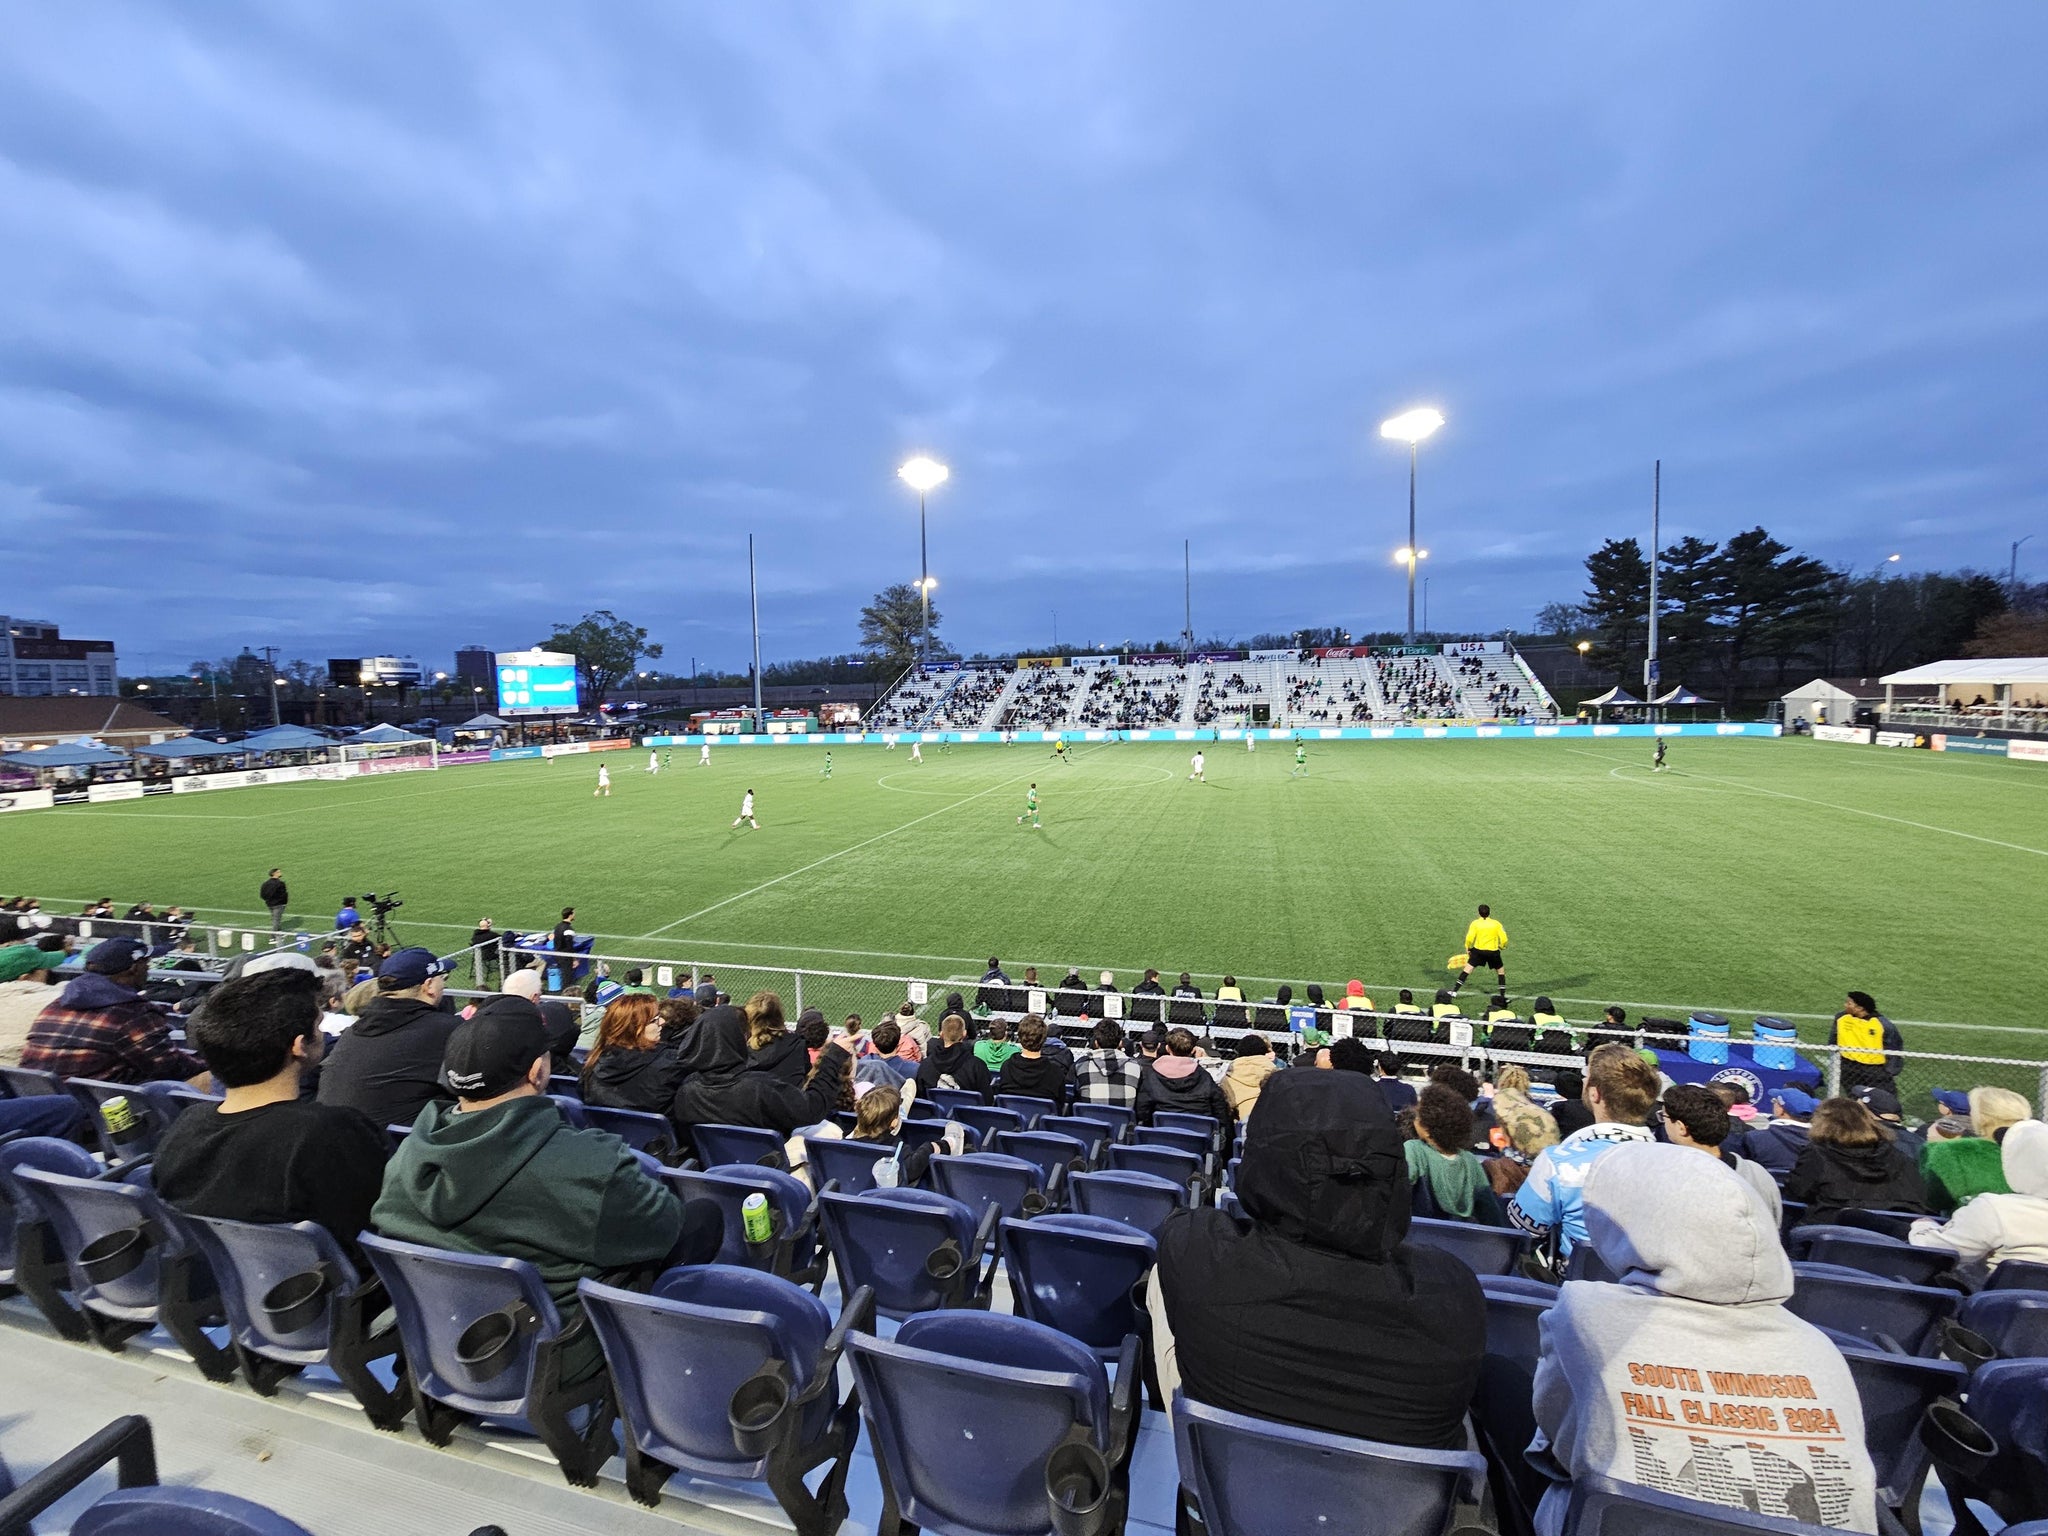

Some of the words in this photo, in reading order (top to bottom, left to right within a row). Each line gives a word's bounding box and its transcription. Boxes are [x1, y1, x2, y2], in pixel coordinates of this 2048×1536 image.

[1461, 643, 1485, 652] USA
[1298, 1018, 1307, 1029] 6
[1628, 1362, 1704, 1392] SOUTH
[1706, 1370, 1817, 1399] WINDSOR
[1621, 1392, 1675, 1421] FALL
[1680, 1399, 1779, 1431] CLASSIC
[1783, 1407, 1841, 1433] 2024
